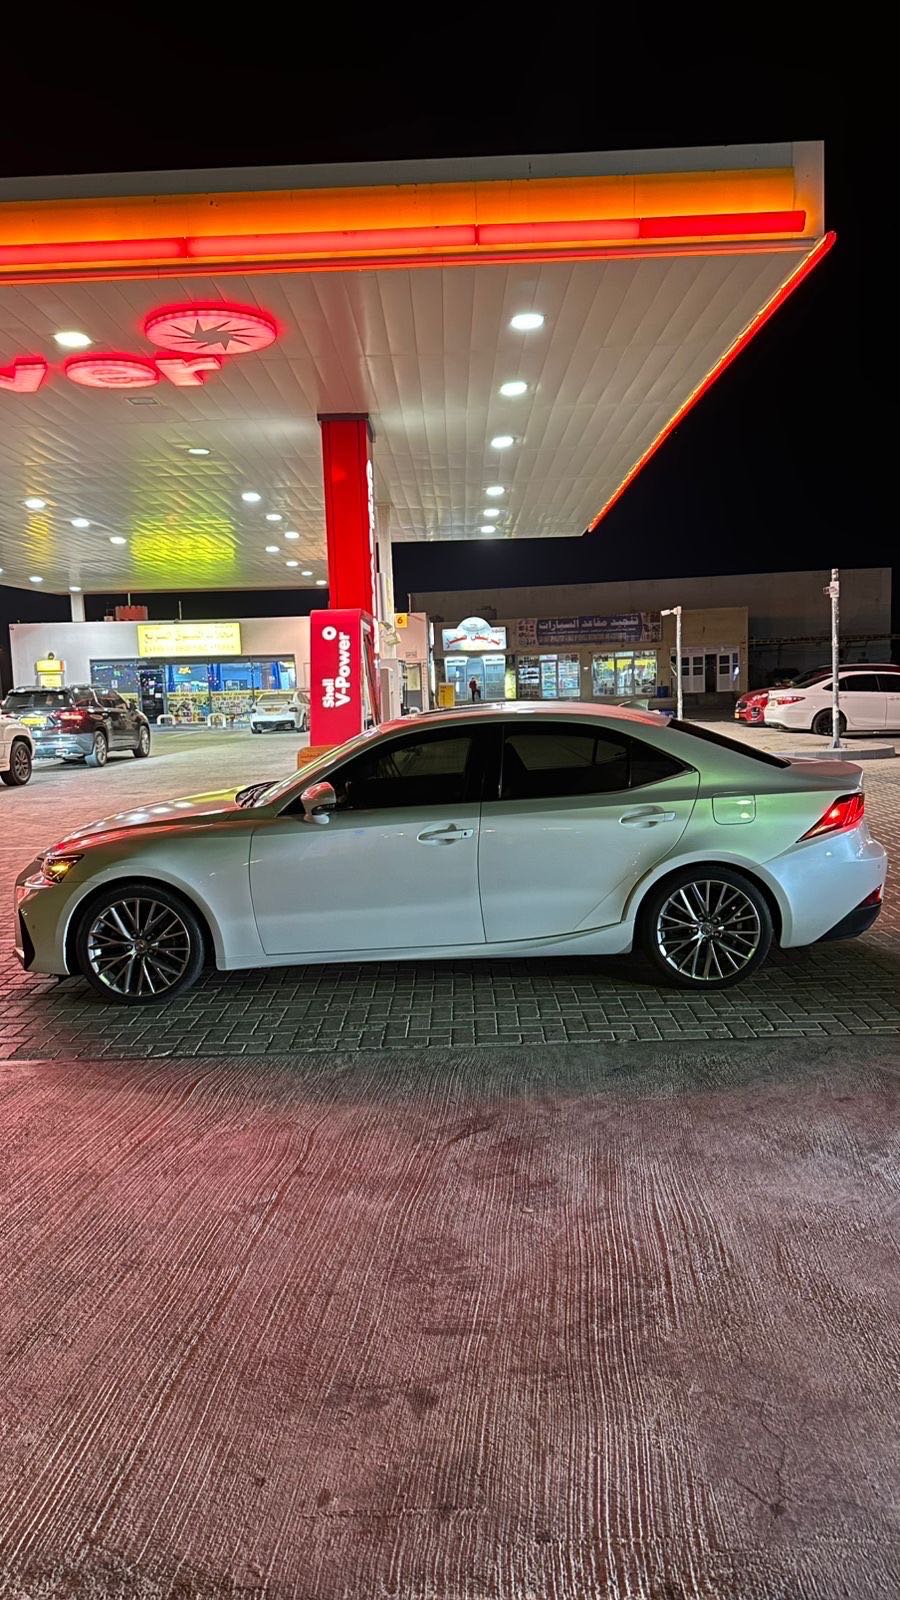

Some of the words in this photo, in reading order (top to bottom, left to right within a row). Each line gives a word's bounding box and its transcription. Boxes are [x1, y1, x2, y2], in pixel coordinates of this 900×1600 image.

[397, 616, 403, 624] 6
[538, 619, 580, 632] السيارات
[582, 618, 607, 629] مقاعد
[610, 615, 639, 630] تنجيد
[335, 631, 351, 708] V-Power
[322, 678, 335, 708] Shell
